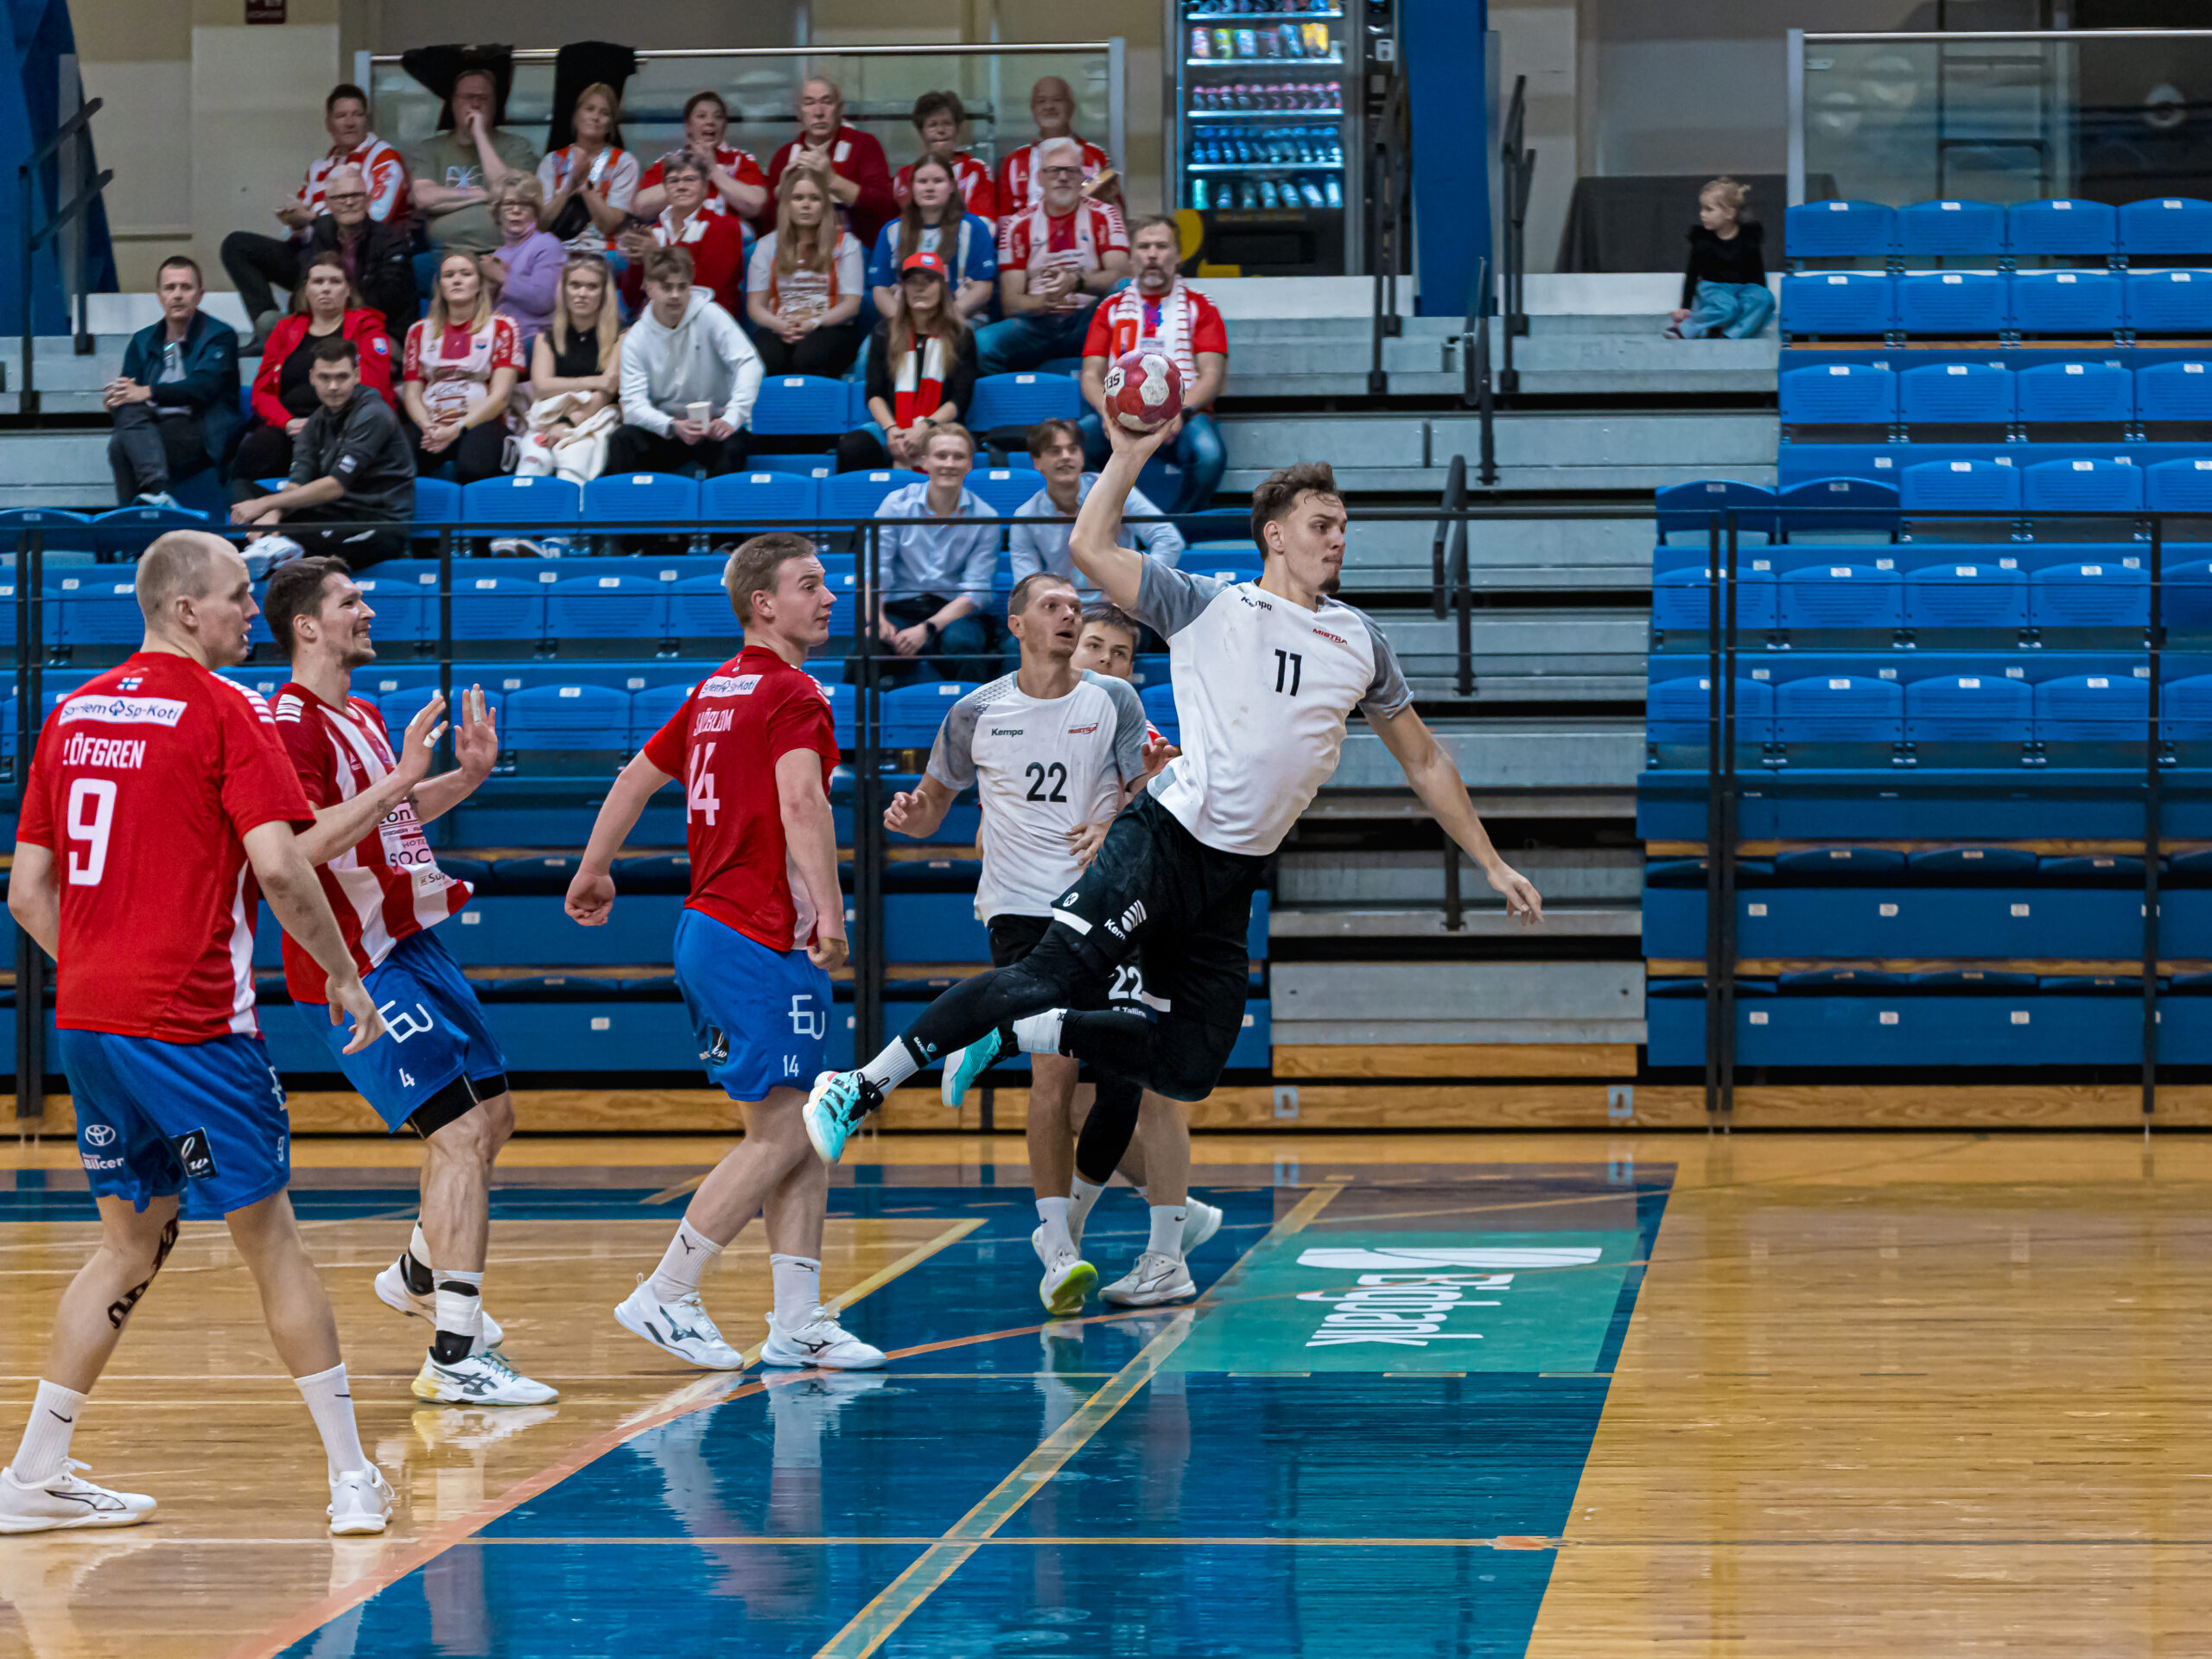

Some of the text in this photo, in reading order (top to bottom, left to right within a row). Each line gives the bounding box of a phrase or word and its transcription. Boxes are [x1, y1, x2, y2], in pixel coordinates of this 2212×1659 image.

[1274, 649, 1302, 696] 11
[124, 704, 179, 719] Sp-Koti
[991, 728, 1024, 737] Kempa
[687, 741, 721, 826] 14
[1025, 761, 1068, 803] 22
[67, 778, 118, 887] 9
[1108, 964, 1143, 1001] 22
[398, 1067, 416, 1088] 4
[783, 1054, 800, 1077] 14
